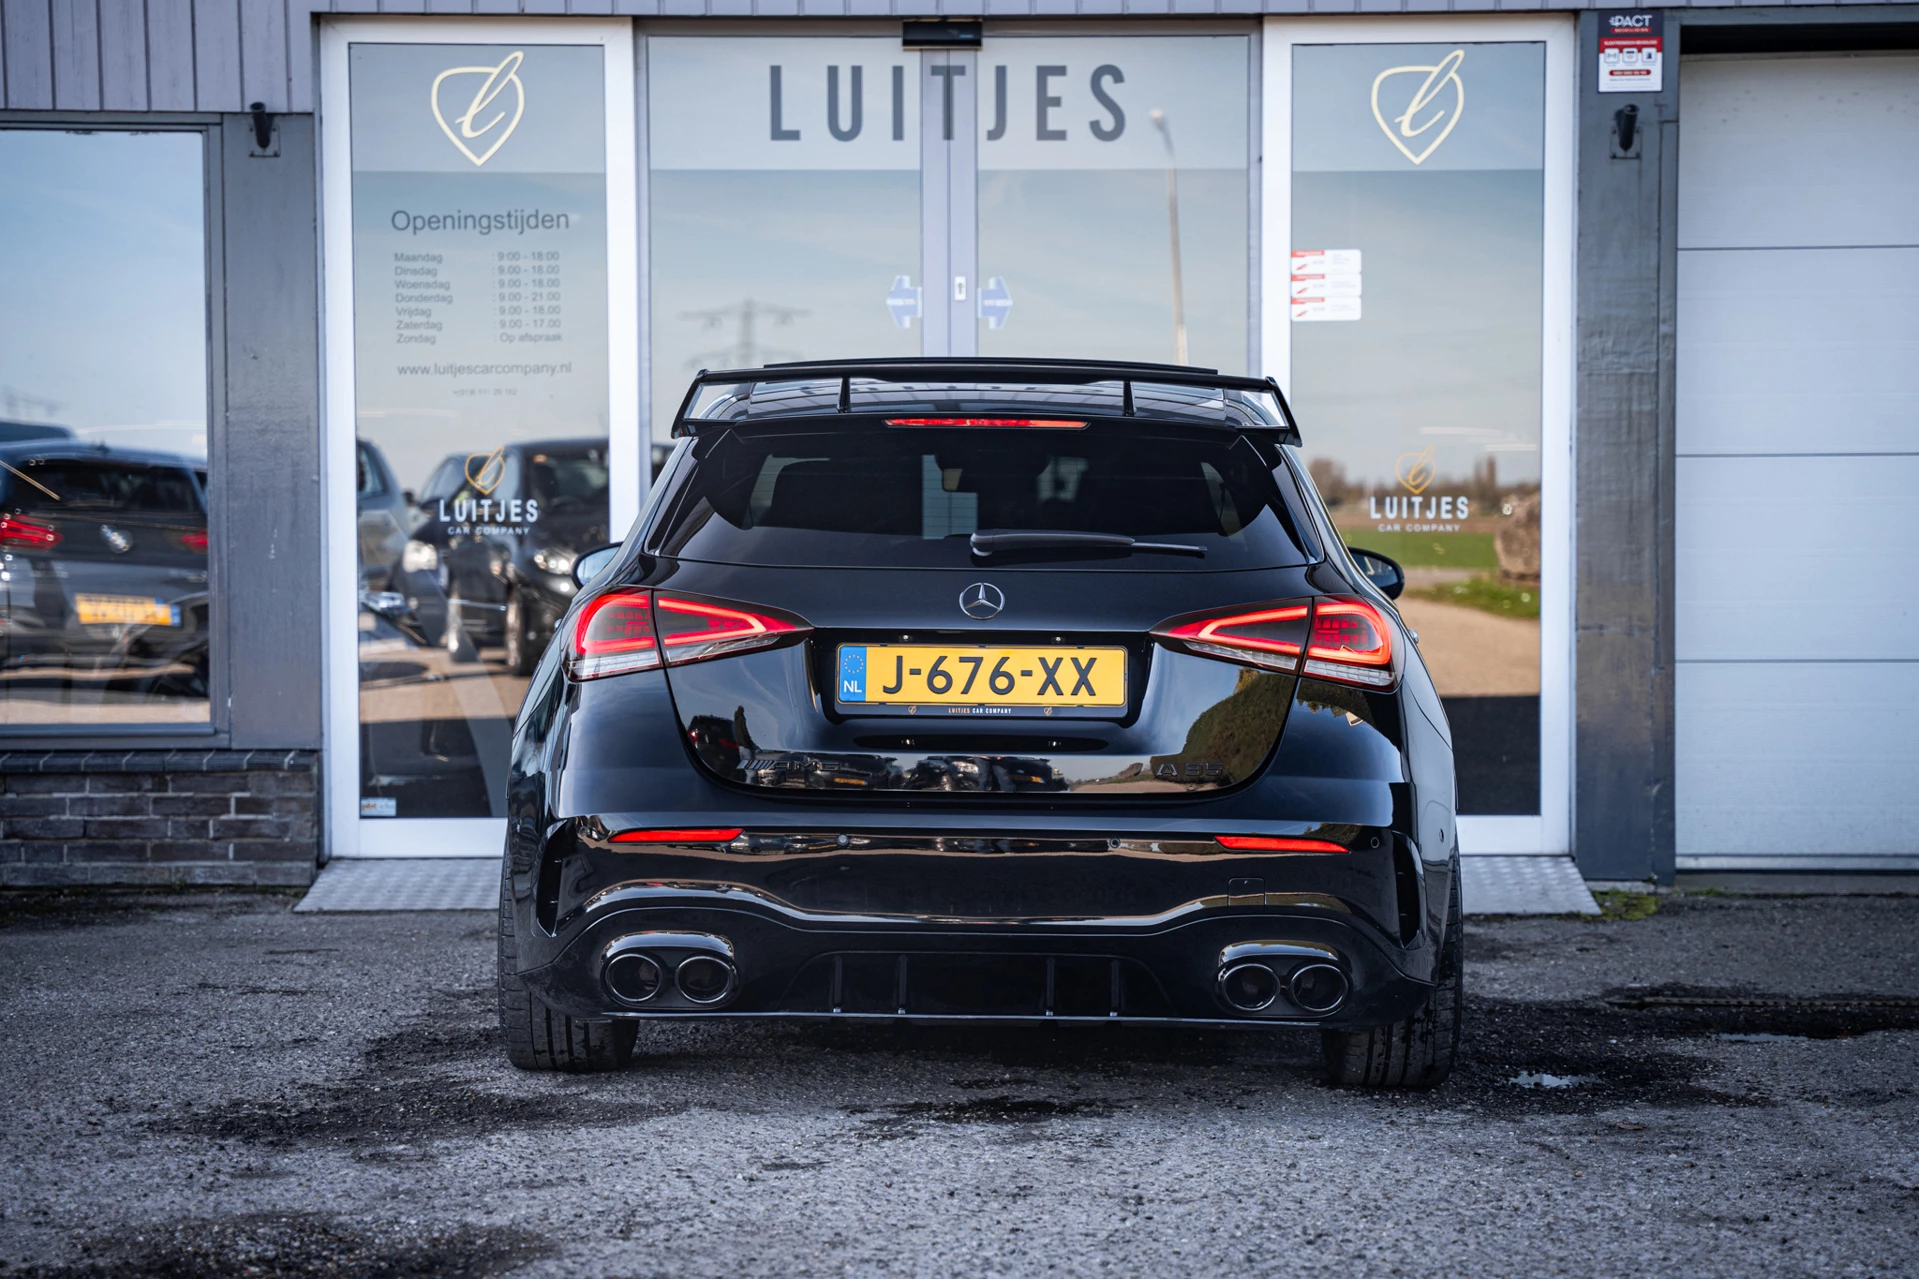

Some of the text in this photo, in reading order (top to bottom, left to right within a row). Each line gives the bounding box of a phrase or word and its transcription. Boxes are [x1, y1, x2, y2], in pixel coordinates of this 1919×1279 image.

[770, 64, 1126, 142] LUITJES
[391, 209, 570, 236] Openingstijden
[394, 252, 443, 264] Maandag
[394, 266, 437, 277] Dinsdag
[395, 279, 451, 291] Woensdag
[395, 292, 453, 305] Donderdag
[396, 306, 432, 318] Vrijdag
[396, 320, 443, 332] Zaterdag
[396, 333, 436, 345] Zondag
[499, 332, 516, 343] Op
[518, 332, 563, 343] afspraak
[397, 362, 572, 377] www.luitjescarcompany.nl
[439, 499, 538, 523] LUITJES
[1369, 496, 1469, 520] LUITJES
[447, 526, 530, 535] CAR COMPANY
[1378, 523, 1461, 533] CAR COMPANY
[882, 655, 1097, 696] J-676-XX
[843, 680, 862, 693] NL
